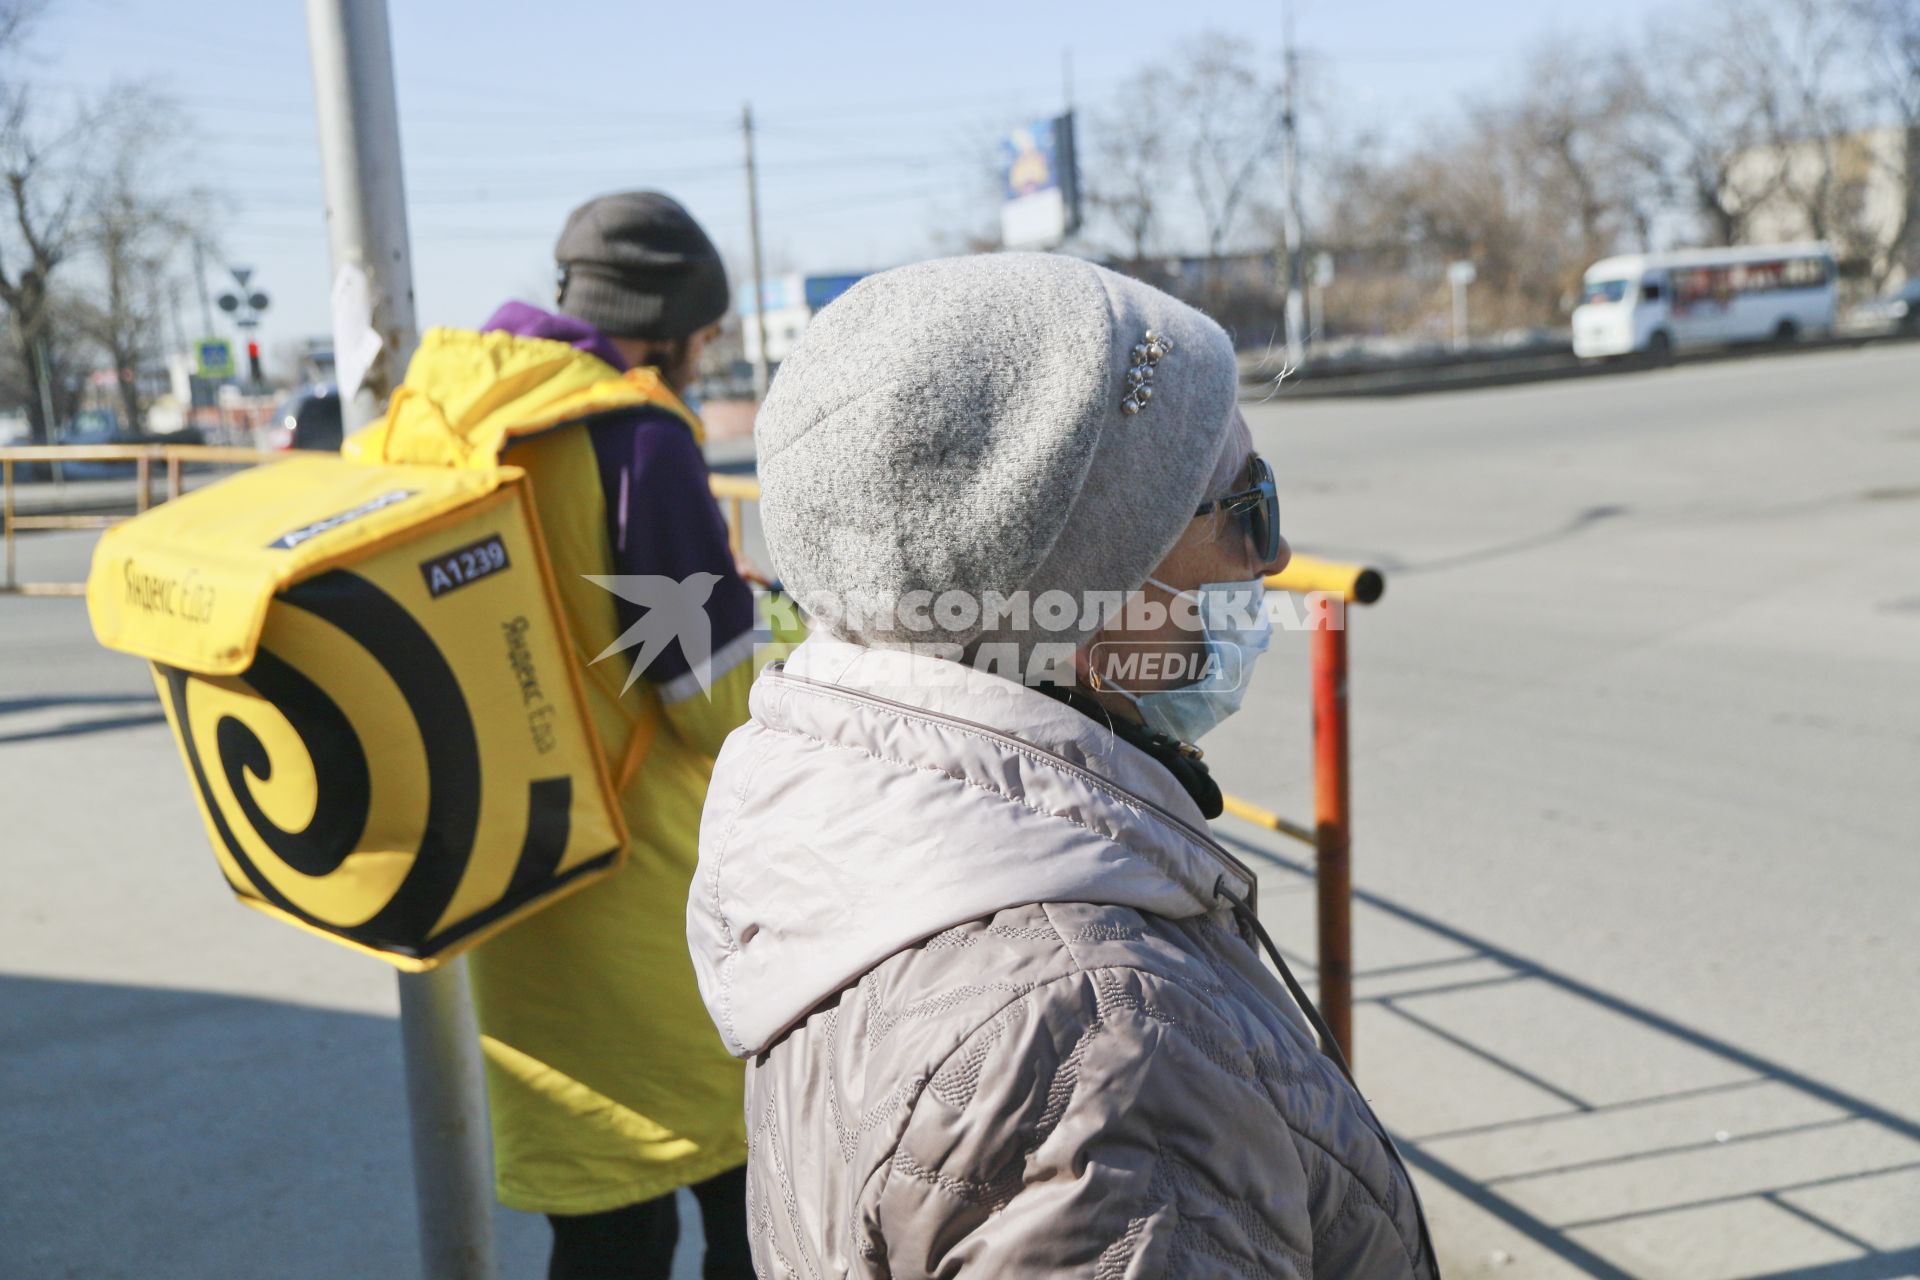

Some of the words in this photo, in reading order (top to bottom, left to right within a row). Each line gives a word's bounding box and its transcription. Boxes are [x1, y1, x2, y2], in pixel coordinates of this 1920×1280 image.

[431, 542, 505, 594] A1239
[502, 615, 544, 707] Яндекс
[528, 704, 557, 755] Еда
